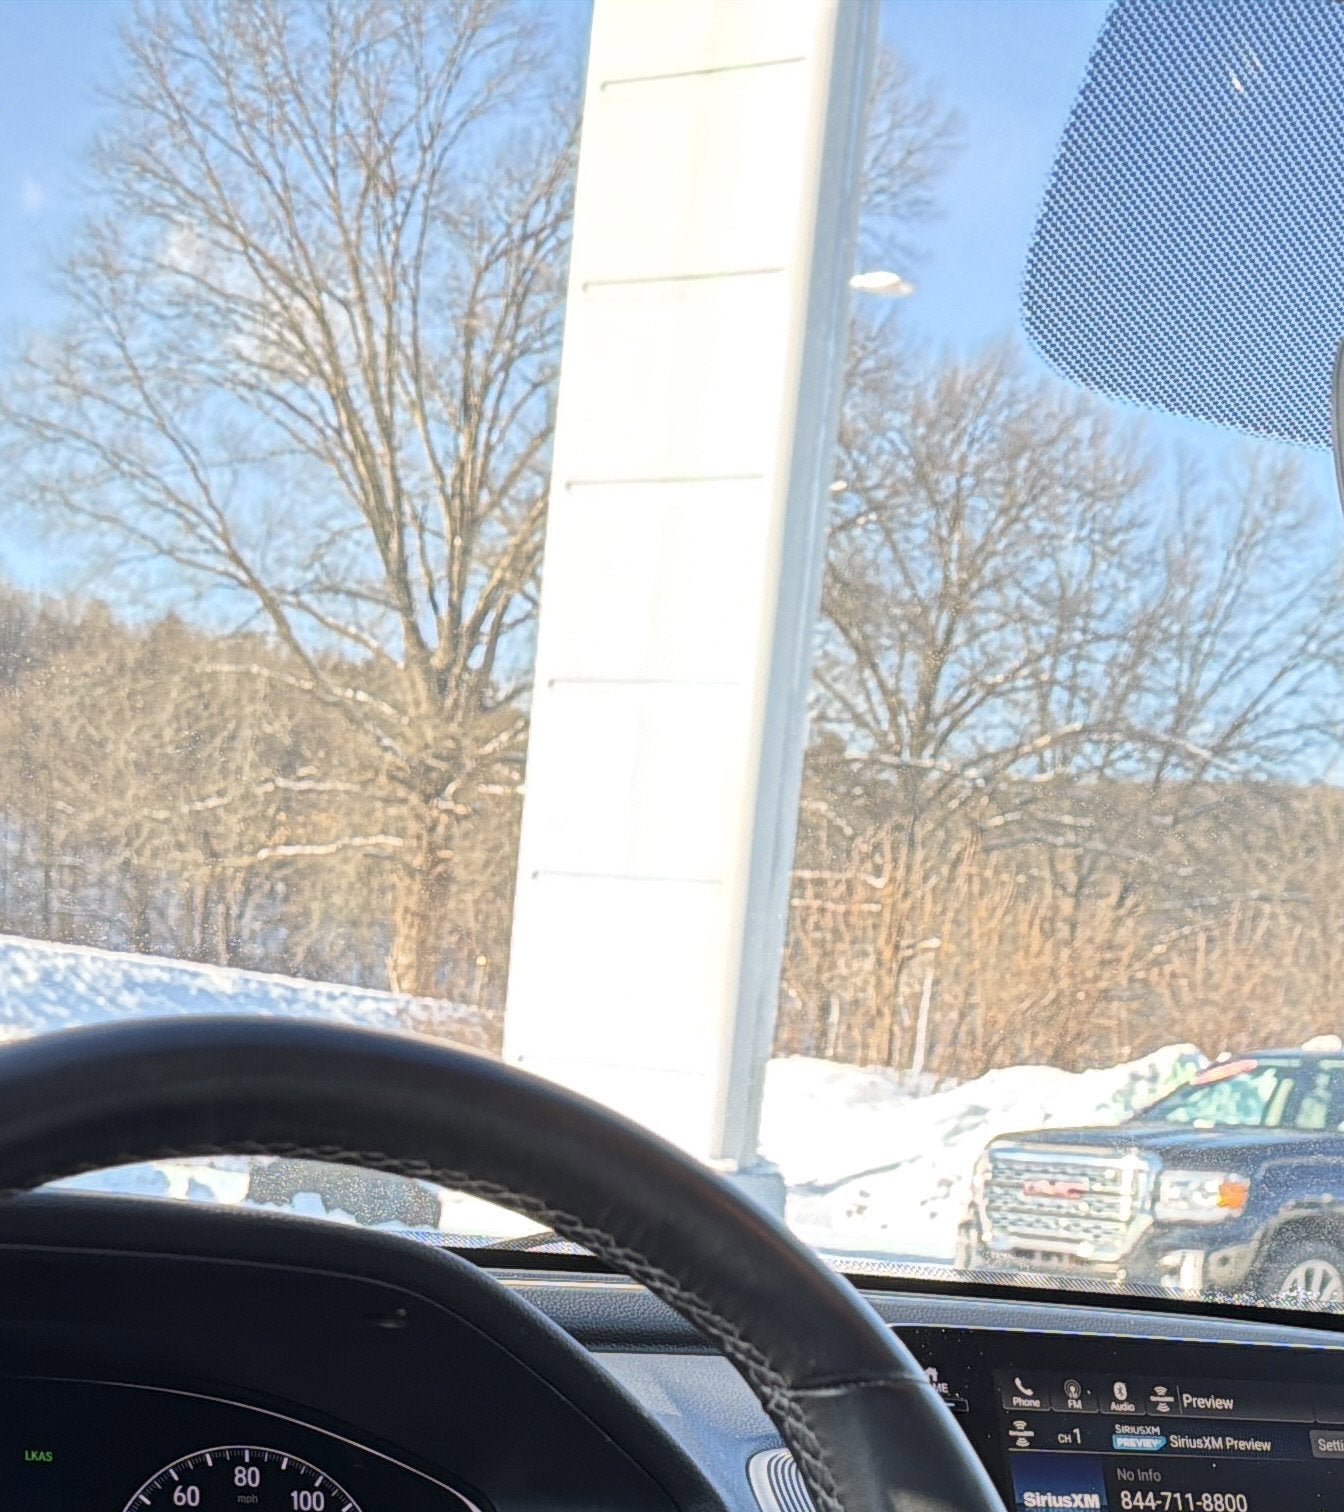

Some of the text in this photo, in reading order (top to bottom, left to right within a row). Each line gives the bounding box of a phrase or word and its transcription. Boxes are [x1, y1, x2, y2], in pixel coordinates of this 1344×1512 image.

[1012, 1397, 1040, 1409] Phone
[1067, 1399, 1083, 1410] FM
[1110, 1401, 1135, 1413] Audio
[1182, 1393, 1234, 1411] Preview
[1057, 1433, 1072, 1444] CH
[1169, 1434, 1272, 1452] SiriusXM Preview
[24, 1450, 53, 1462] LKAS
[234, 1466, 260, 1488] 80
[1117, 1468, 1162, 1483] No Info
[173, 1485, 200, 1507] 60
[290, 1490, 325, 1512] 100
[1022, 1492, 1101, 1509] SiriusXM
